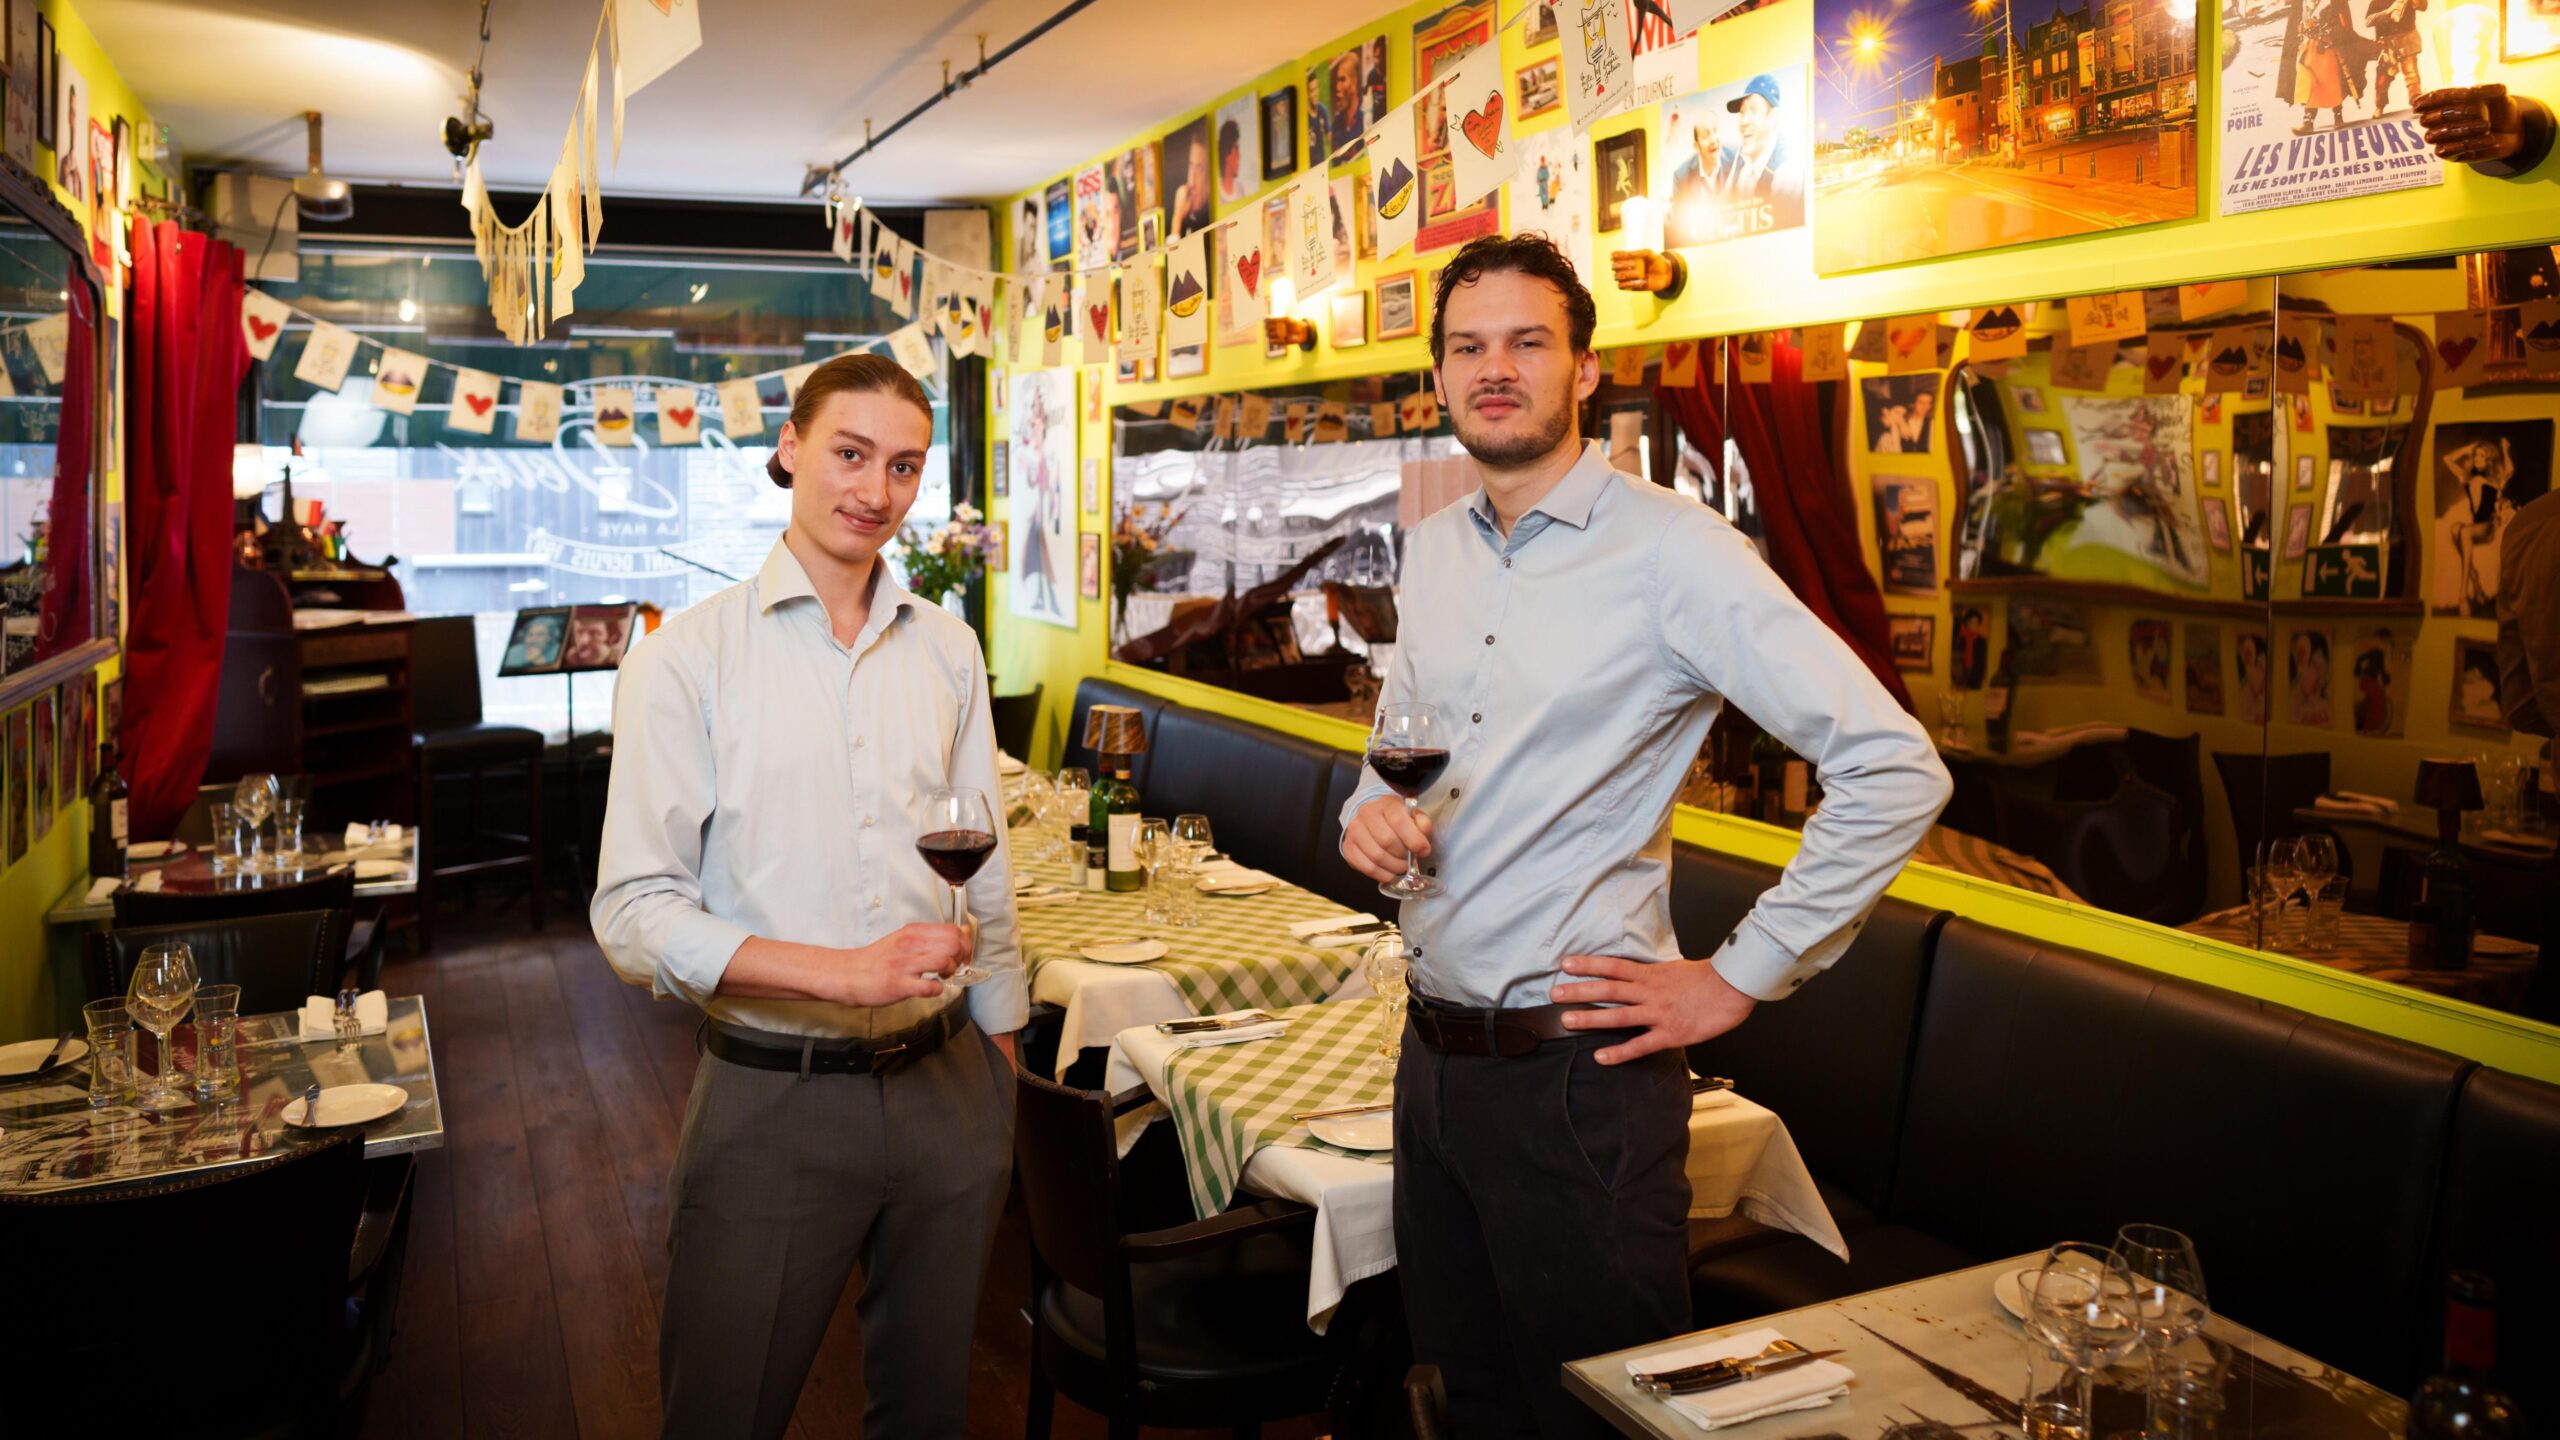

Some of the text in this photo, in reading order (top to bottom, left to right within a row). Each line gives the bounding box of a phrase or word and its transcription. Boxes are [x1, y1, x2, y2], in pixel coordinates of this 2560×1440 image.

[2226, 181, 2250, 196] ILS
[2250, 178, 2270, 192] NE
[2270, 172, 2306, 188] SONT
[2308, 166, 2340, 182] PAS
[2343, 161, 2371, 177] NÉS
[2373, 153, 2428, 172] D'HIER
[2234, 120, 2426, 180] LES VISITEURS
